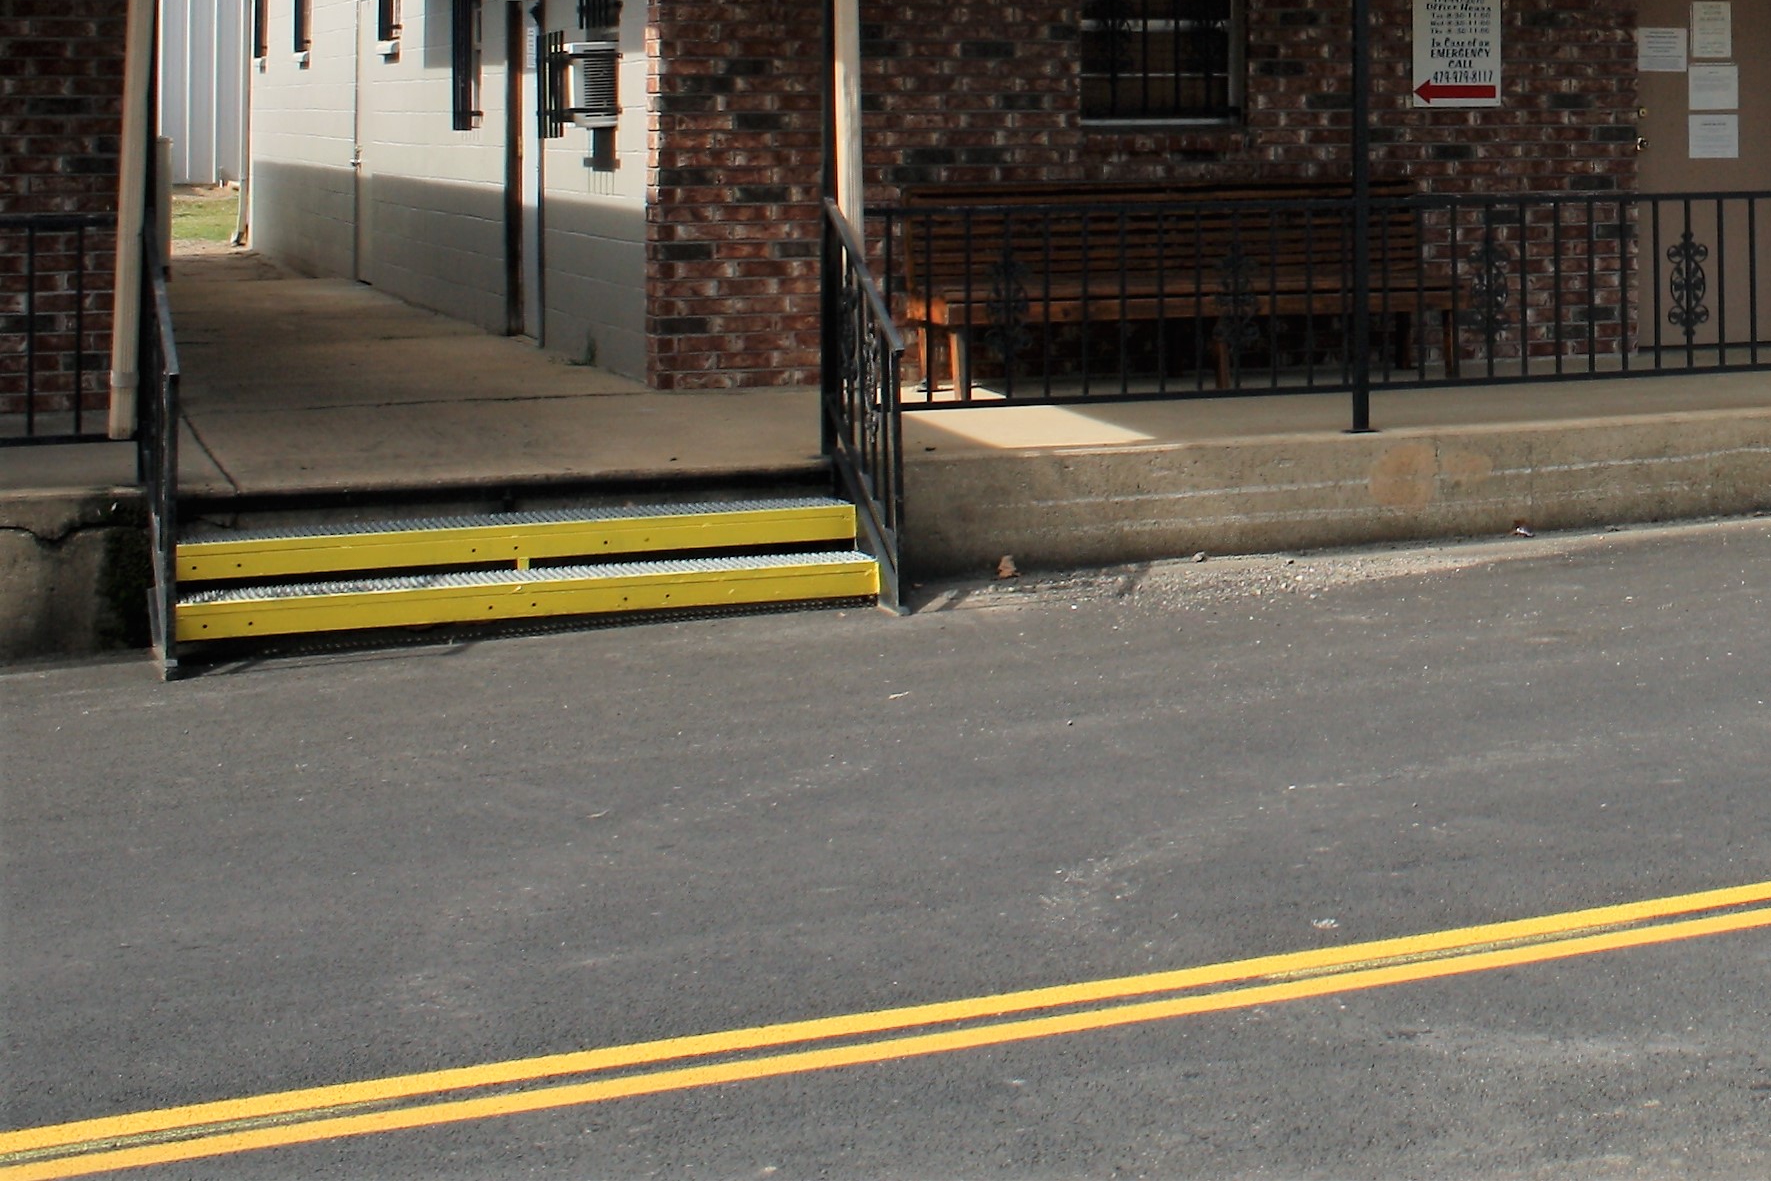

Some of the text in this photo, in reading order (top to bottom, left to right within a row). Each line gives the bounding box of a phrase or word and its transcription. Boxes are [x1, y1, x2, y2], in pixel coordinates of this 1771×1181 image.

[1426, 3, 1491, 12] Office Hours
[1444, 37, 1464, 48] Case
[1467, 38, 1477, 47] of
[1430, 48, 1491, 59] EMERGENCY
[1448, 60, 1473, 69] CALL
